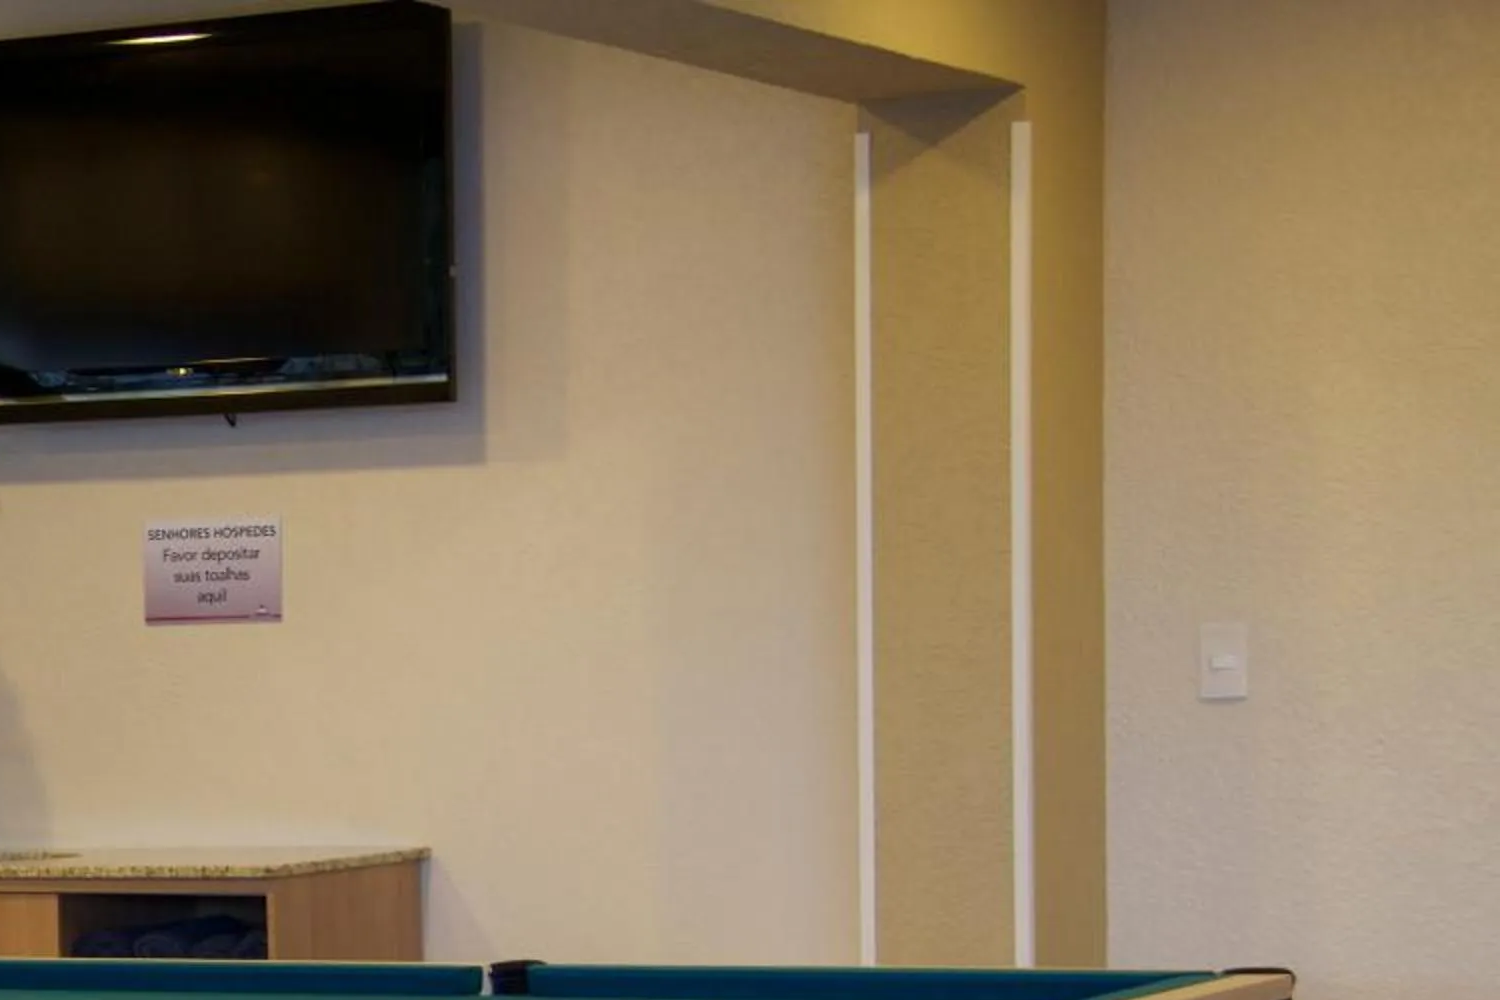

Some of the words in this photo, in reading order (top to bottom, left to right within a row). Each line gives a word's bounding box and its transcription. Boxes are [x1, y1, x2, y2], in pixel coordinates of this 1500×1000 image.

[148, 528, 210, 541] SENHORES
[163, 549, 197, 562] Favor
[202, 548, 260, 564] depositar
[205, 567, 250, 581] toalhas
